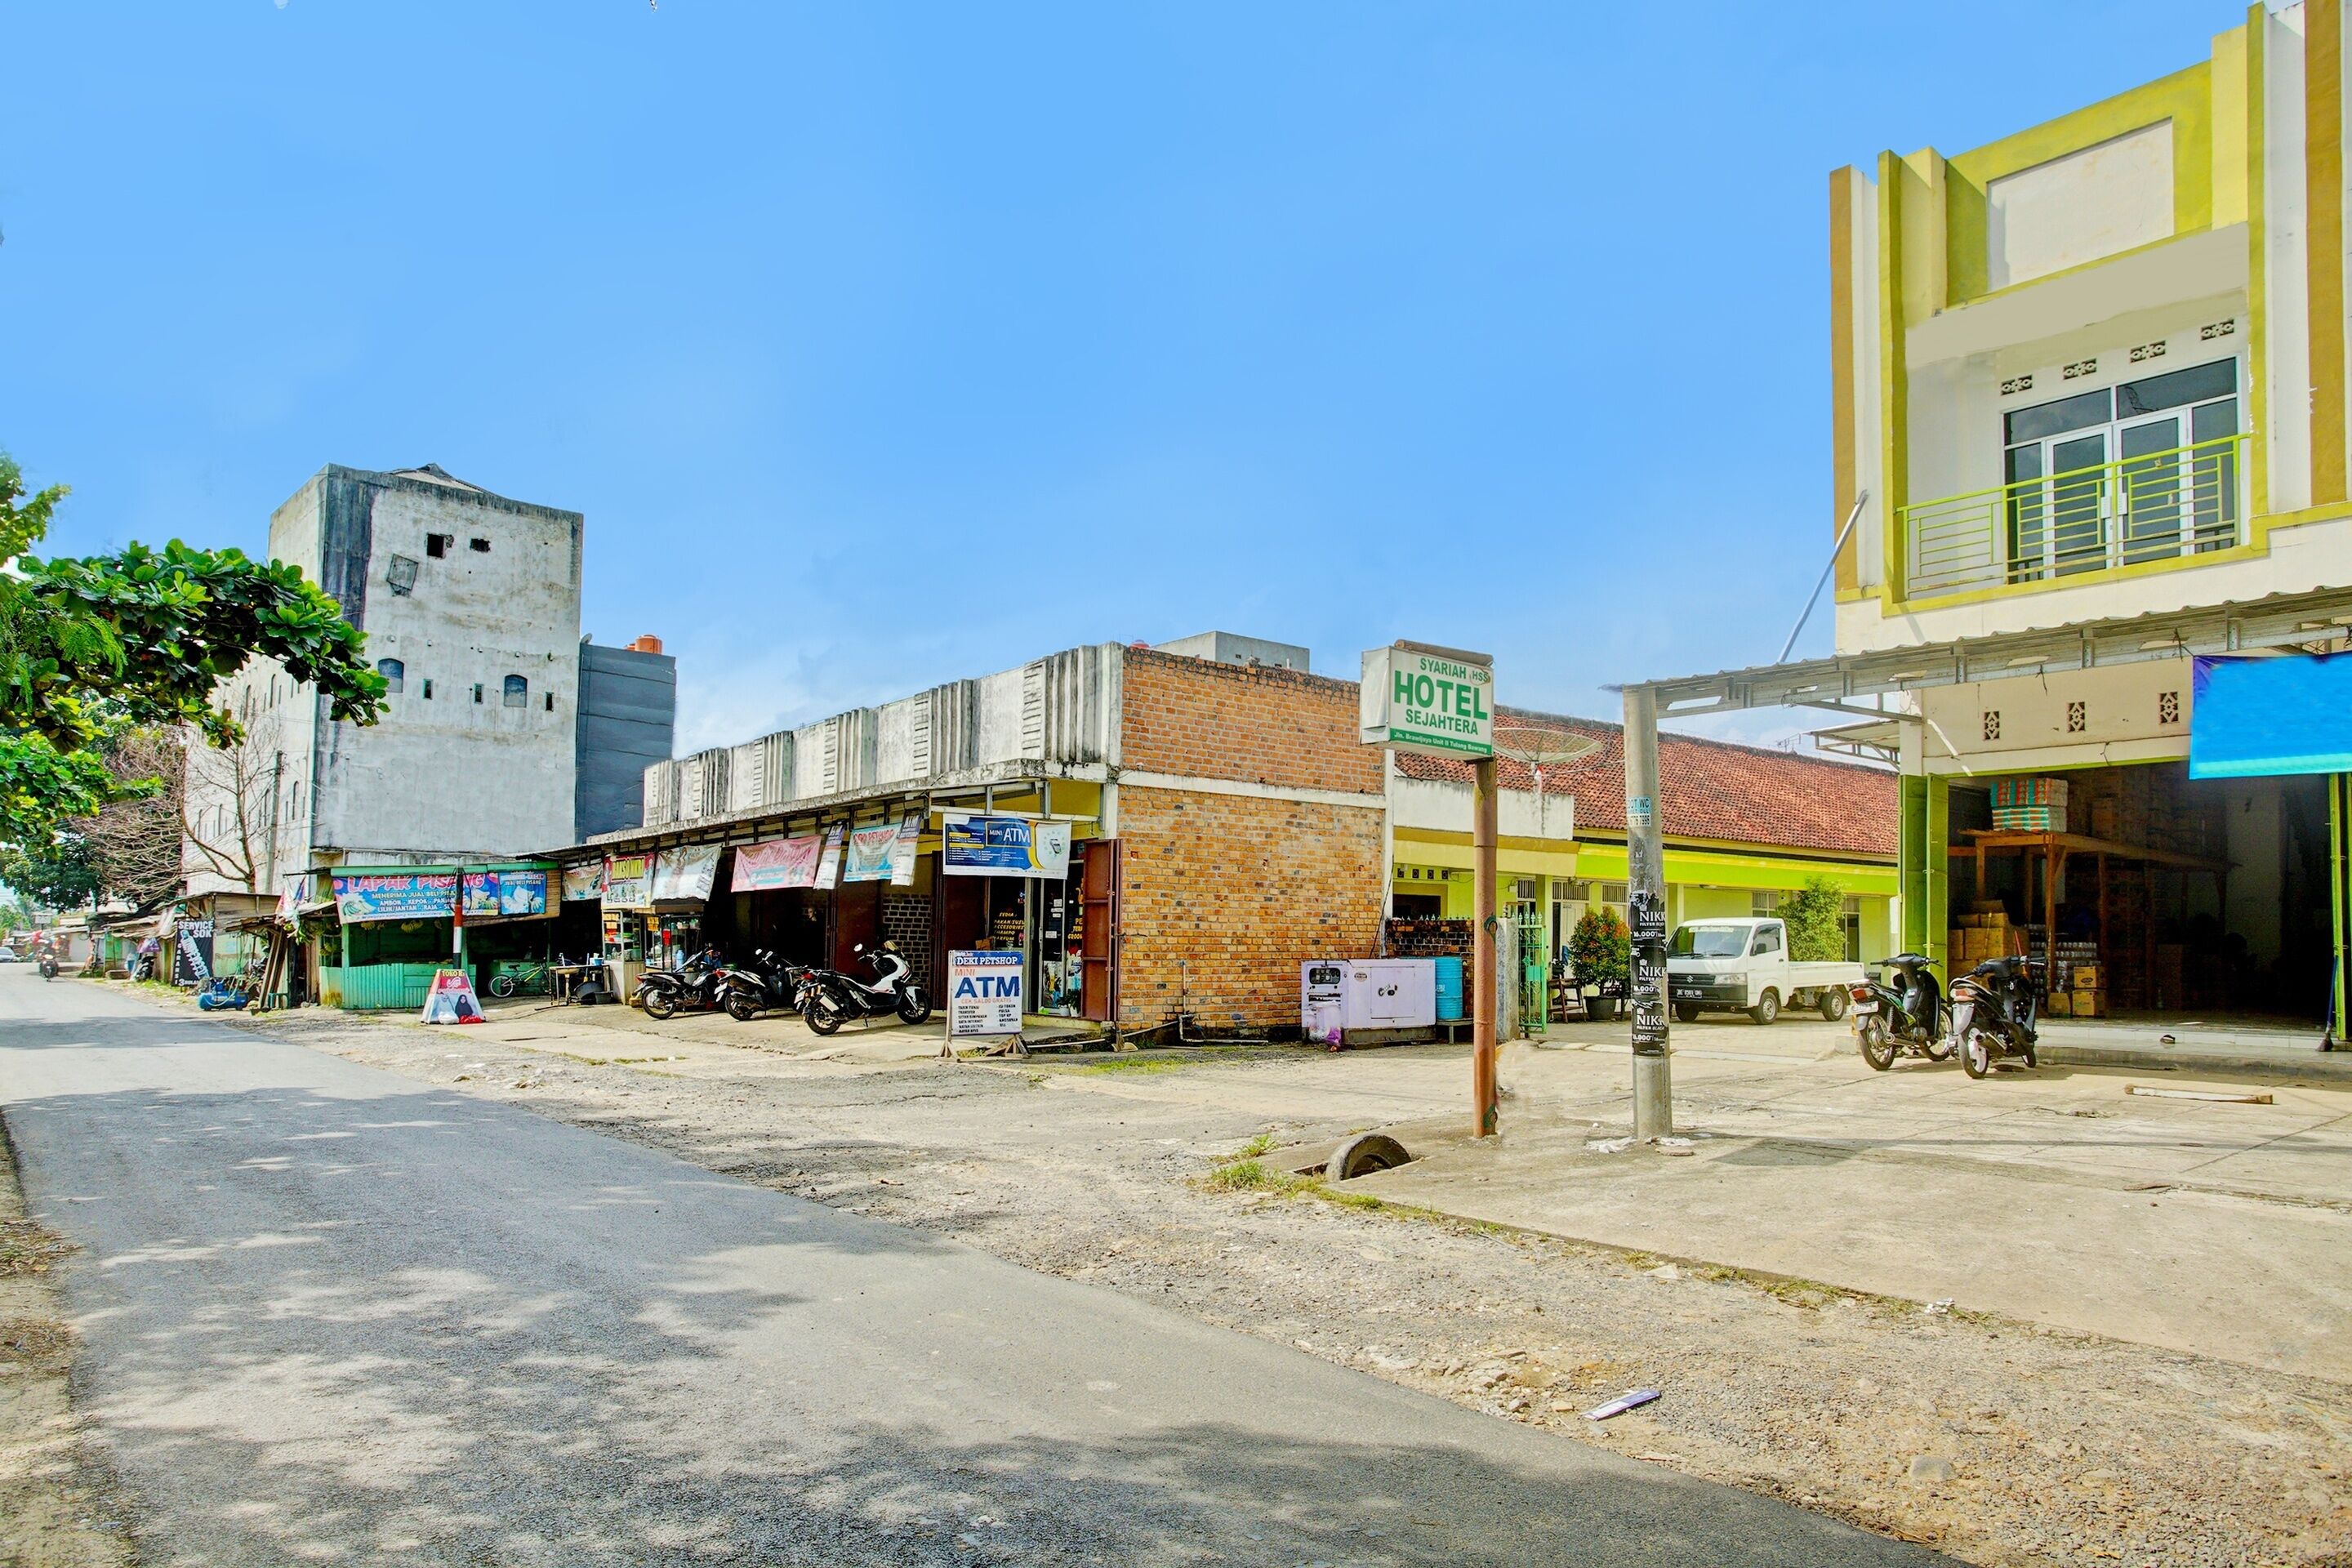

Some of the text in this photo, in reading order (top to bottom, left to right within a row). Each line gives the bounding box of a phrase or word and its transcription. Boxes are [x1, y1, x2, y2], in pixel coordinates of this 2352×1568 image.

[1420, 657, 1489, 683] SYARIAH HSS
[1394, 670, 1488, 720] HOTEL
[1405, 708, 1478, 736] SEJAHTERA
[1405, 733, 1432, 745] Brawijaya
[1432, 737, 1444, 745] Unit
[1450, 740, 1467, 750] Tulang
[1468, 742, 1487, 753] Bawang
[1639, 798, 1650, 808] WC
[1004, 827, 1030, 843] ATM
[347, 875, 413, 893] LAPAK
[178, 920, 214, 930] SERVICE
[193, 929, 212, 938] SOK
[956, 956, 1018, 965] DEKI PETSHOP
[955, 968, 976, 977] MINI
[954, 975, 1020, 999] ATM
